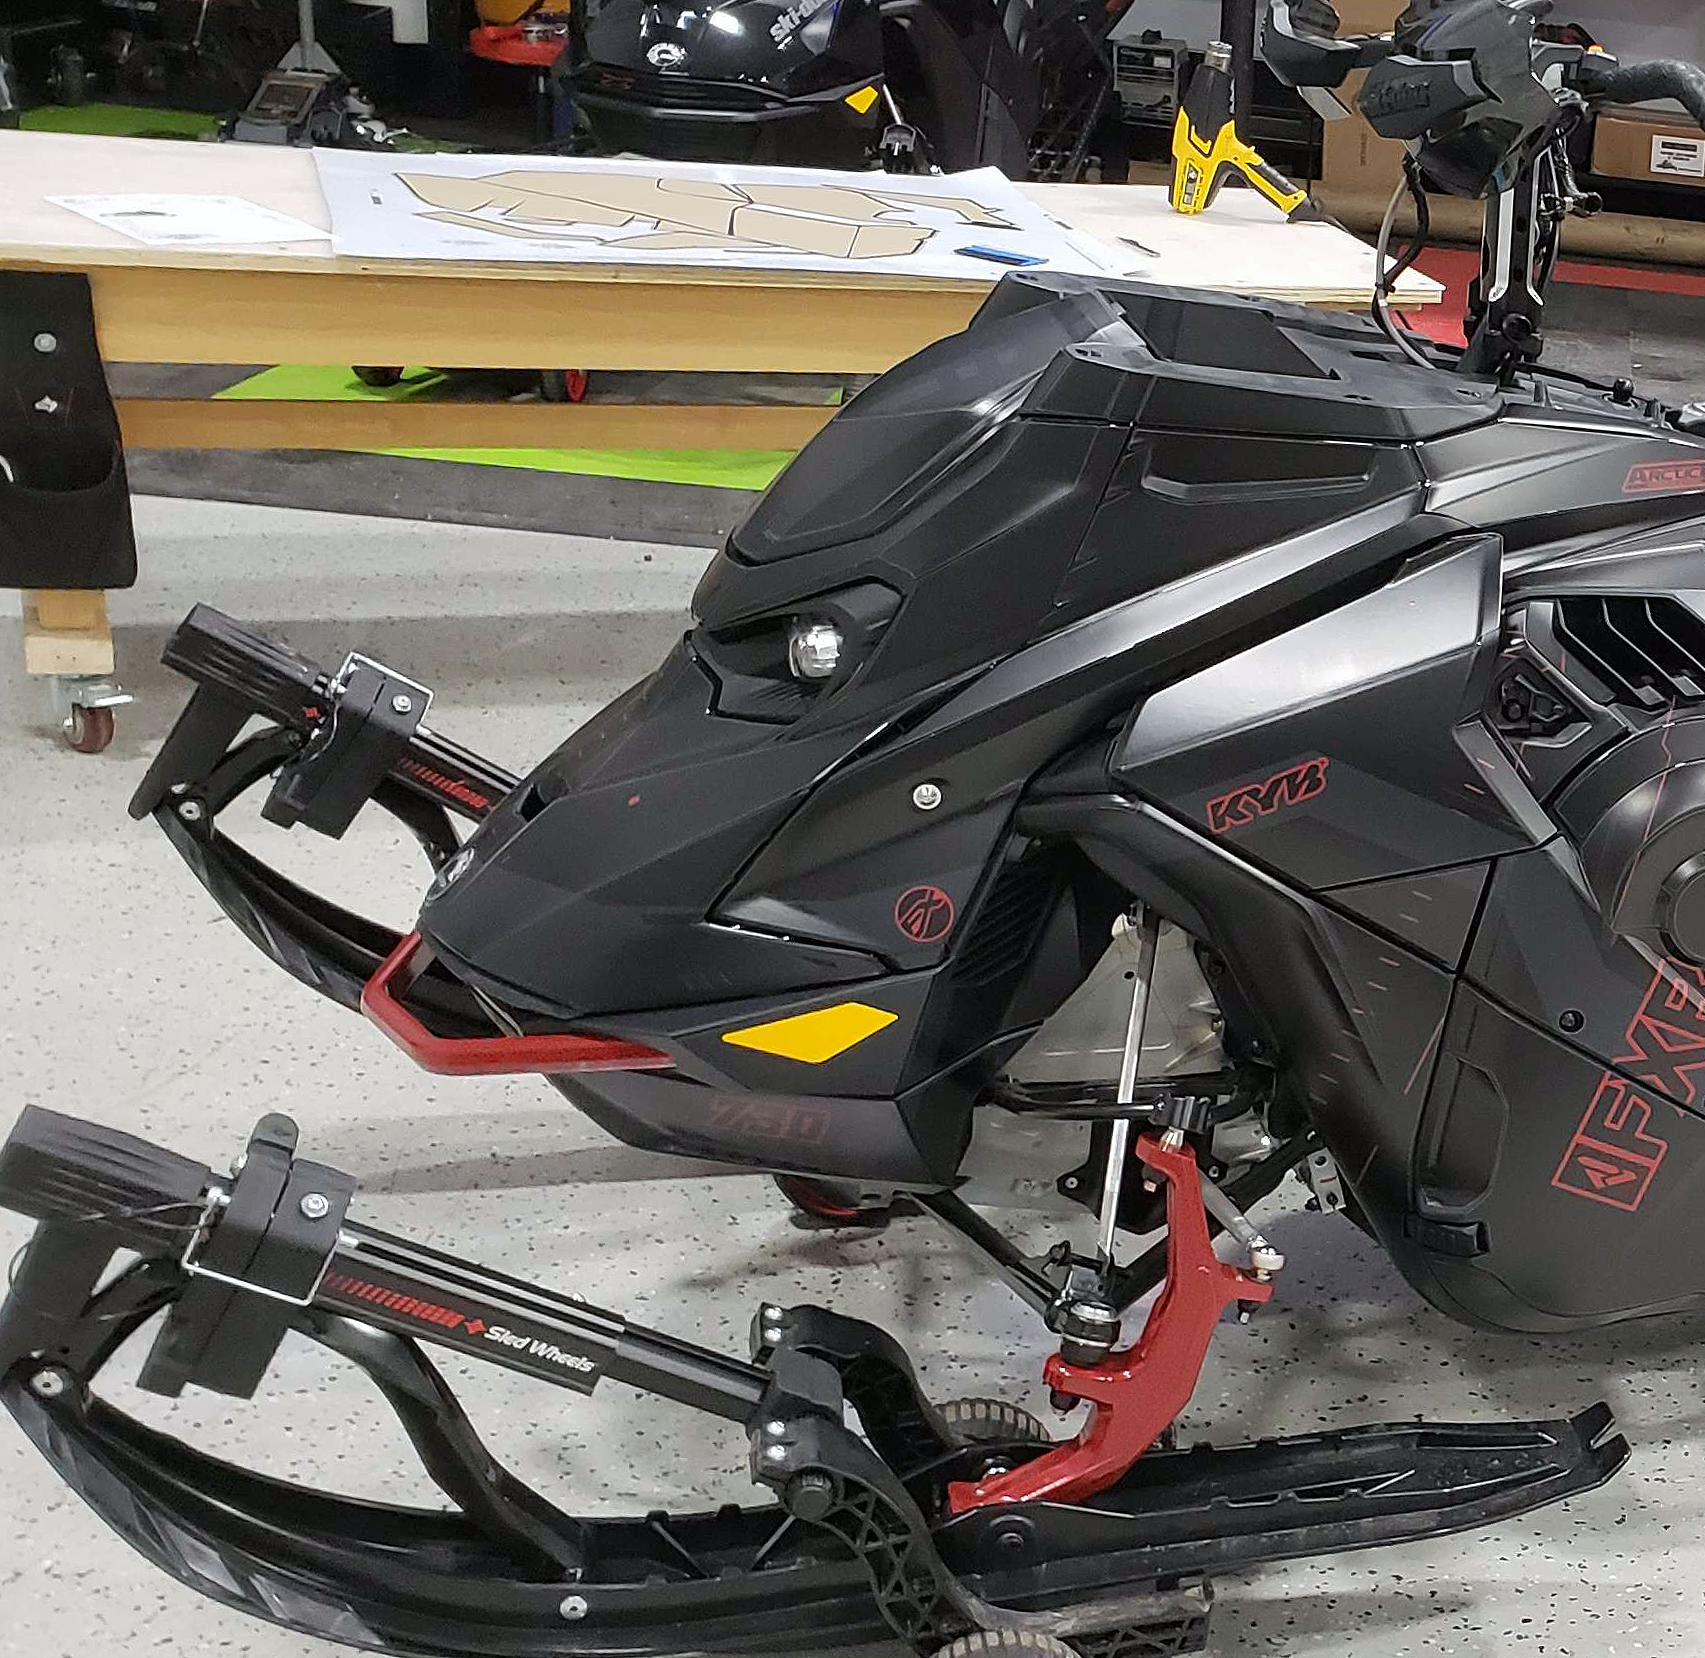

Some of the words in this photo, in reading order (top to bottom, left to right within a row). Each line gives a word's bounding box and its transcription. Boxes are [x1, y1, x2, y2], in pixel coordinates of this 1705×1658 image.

[1206, 757, 1329, 833] KYB
[484, 1326, 532, 1350] Sled
[528, 1339, 596, 1373] Wheels
